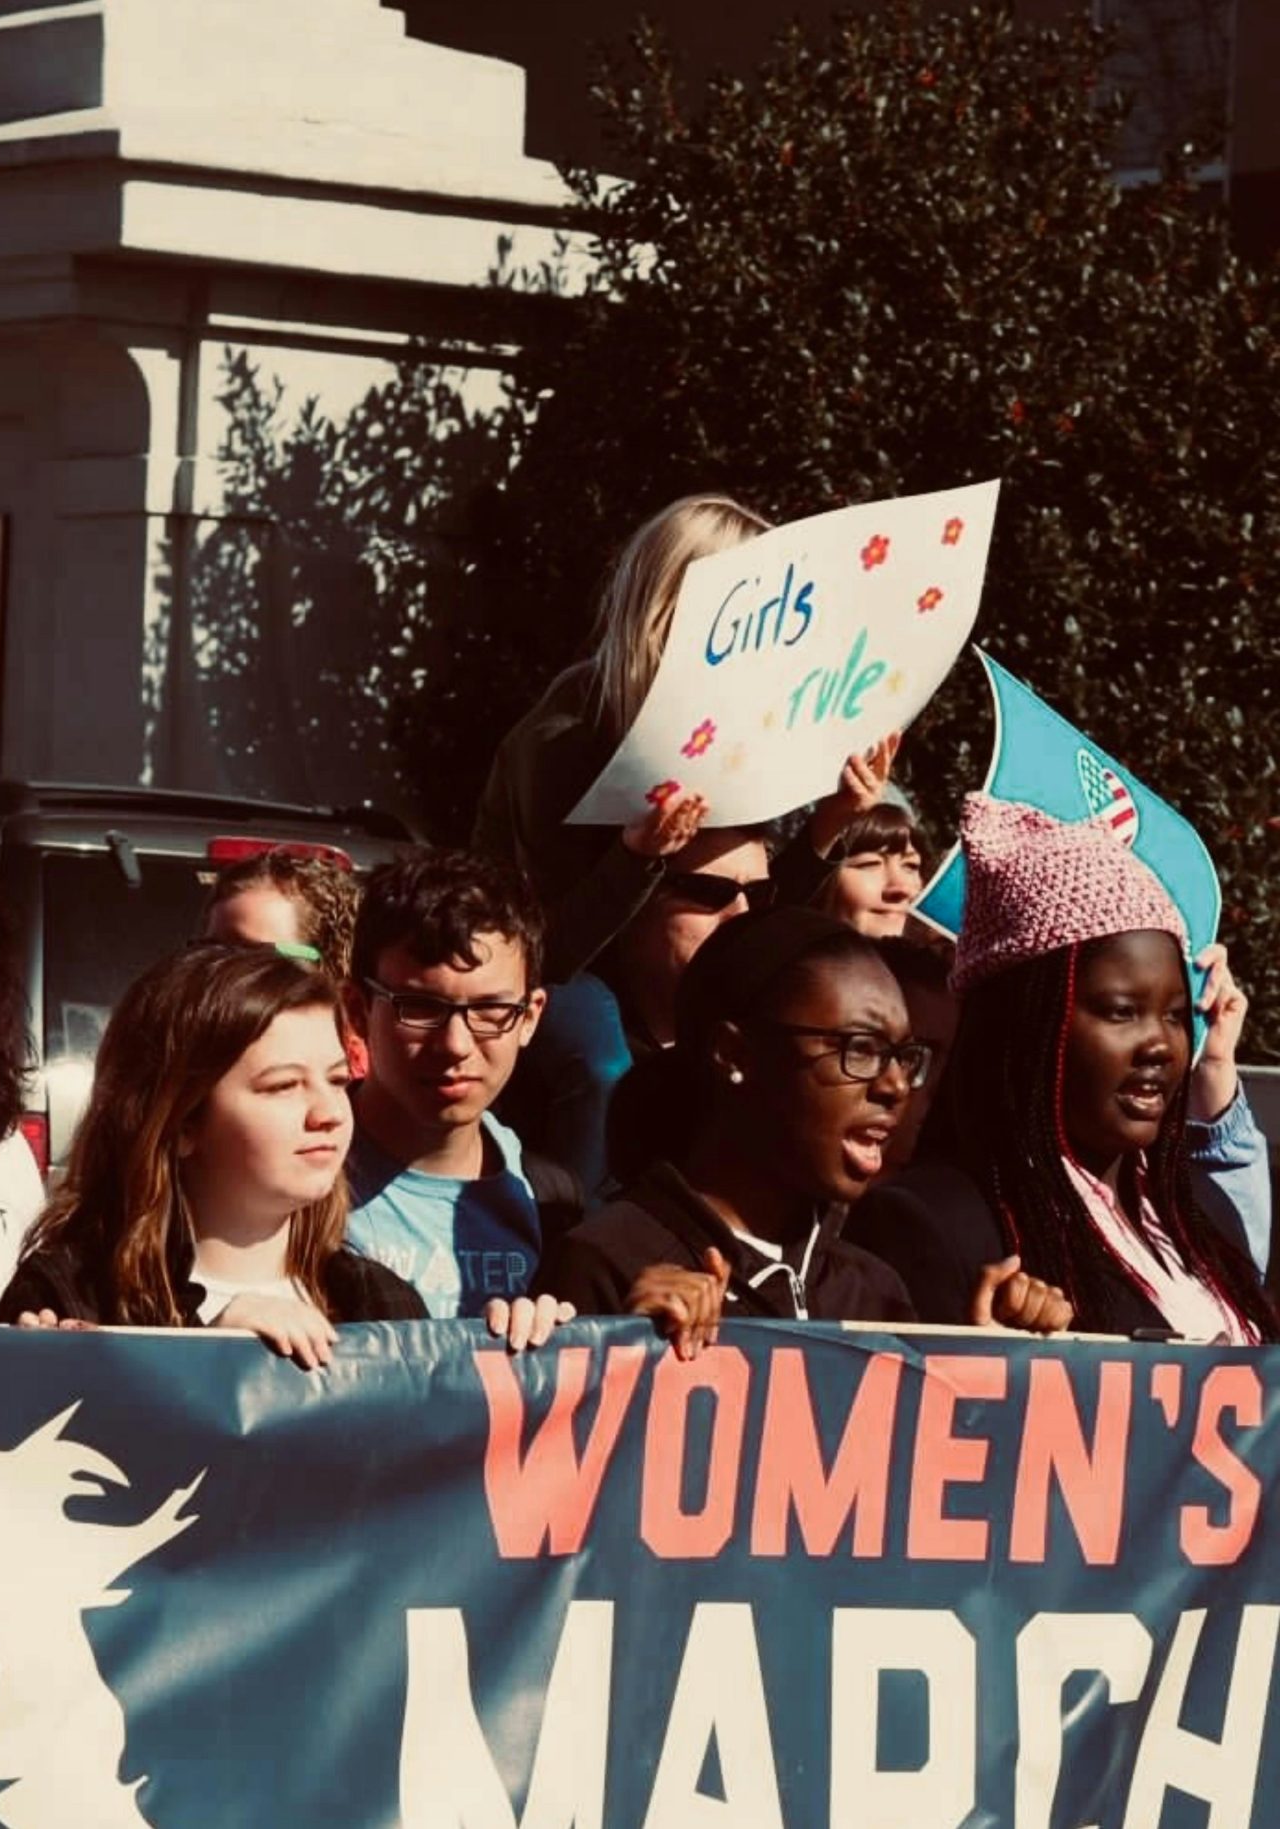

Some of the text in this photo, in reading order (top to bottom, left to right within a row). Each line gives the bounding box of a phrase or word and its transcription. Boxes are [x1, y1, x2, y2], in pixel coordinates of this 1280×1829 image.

[703, 562, 815, 667] Girls
[785, 625, 888, 730] rule
[473, 1346, 1263, 1567] WOMEN'S
[397, 1601, 1280, 1829] MARCH
